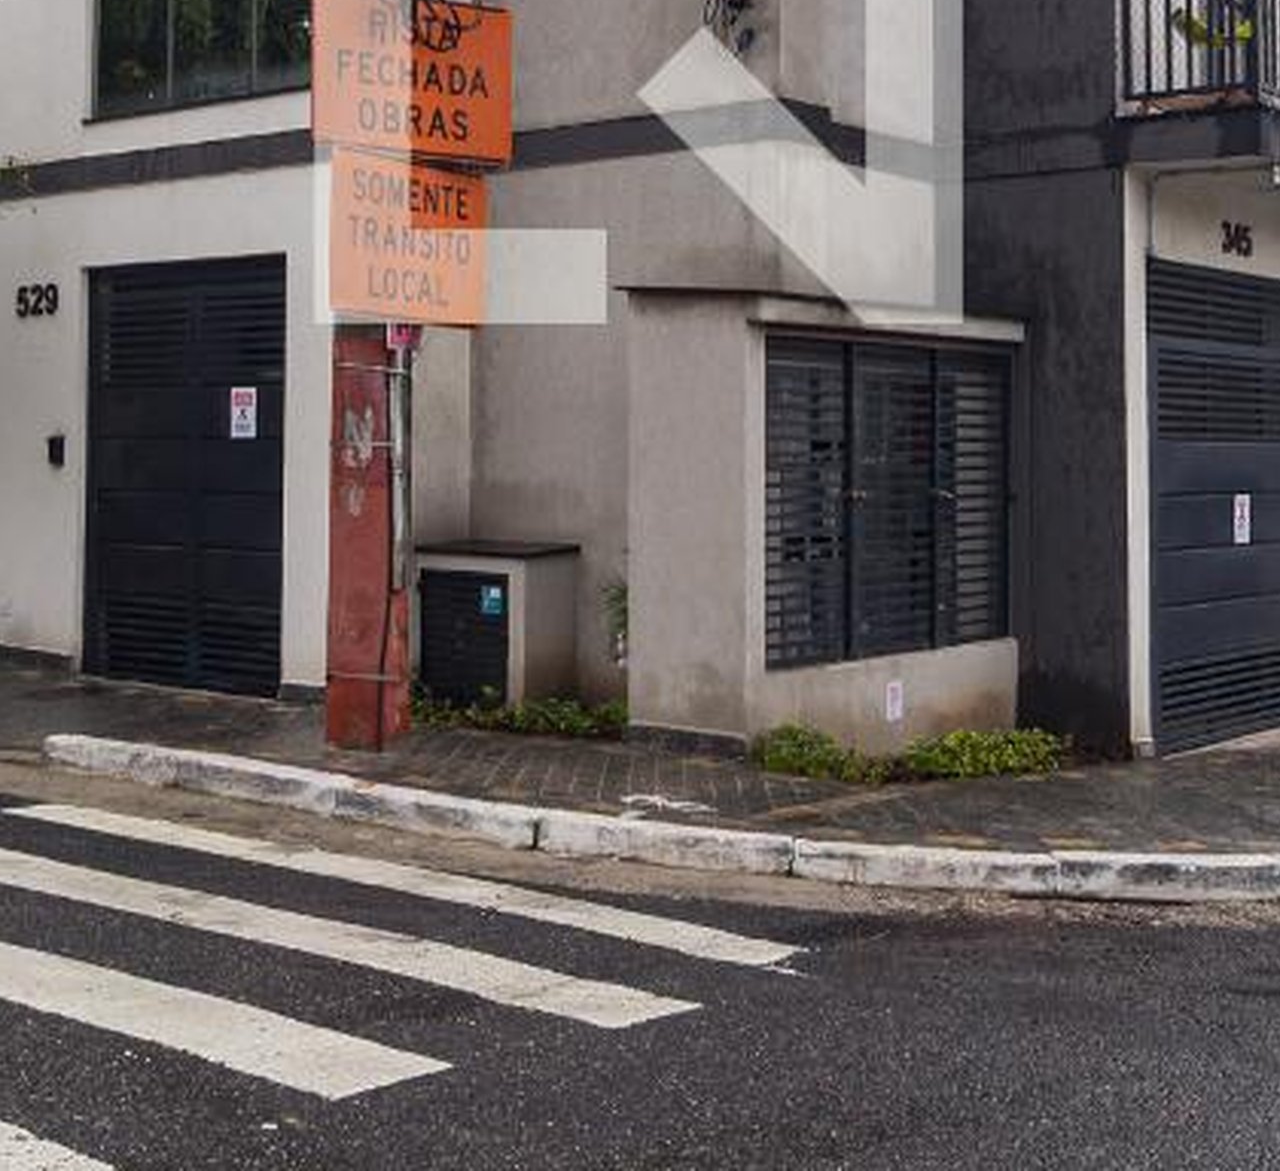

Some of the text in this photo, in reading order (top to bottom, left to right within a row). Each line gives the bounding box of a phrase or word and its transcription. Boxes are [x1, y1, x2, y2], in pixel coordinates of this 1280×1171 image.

[337, 49, 488, 99] FECHADA
[358, 97, 468, 141] OBRAS
[352, 168, 468, 221] SOMENTE
[16, 283, 58, 318] 529
[367, 264, 448, 307] LOCAL
